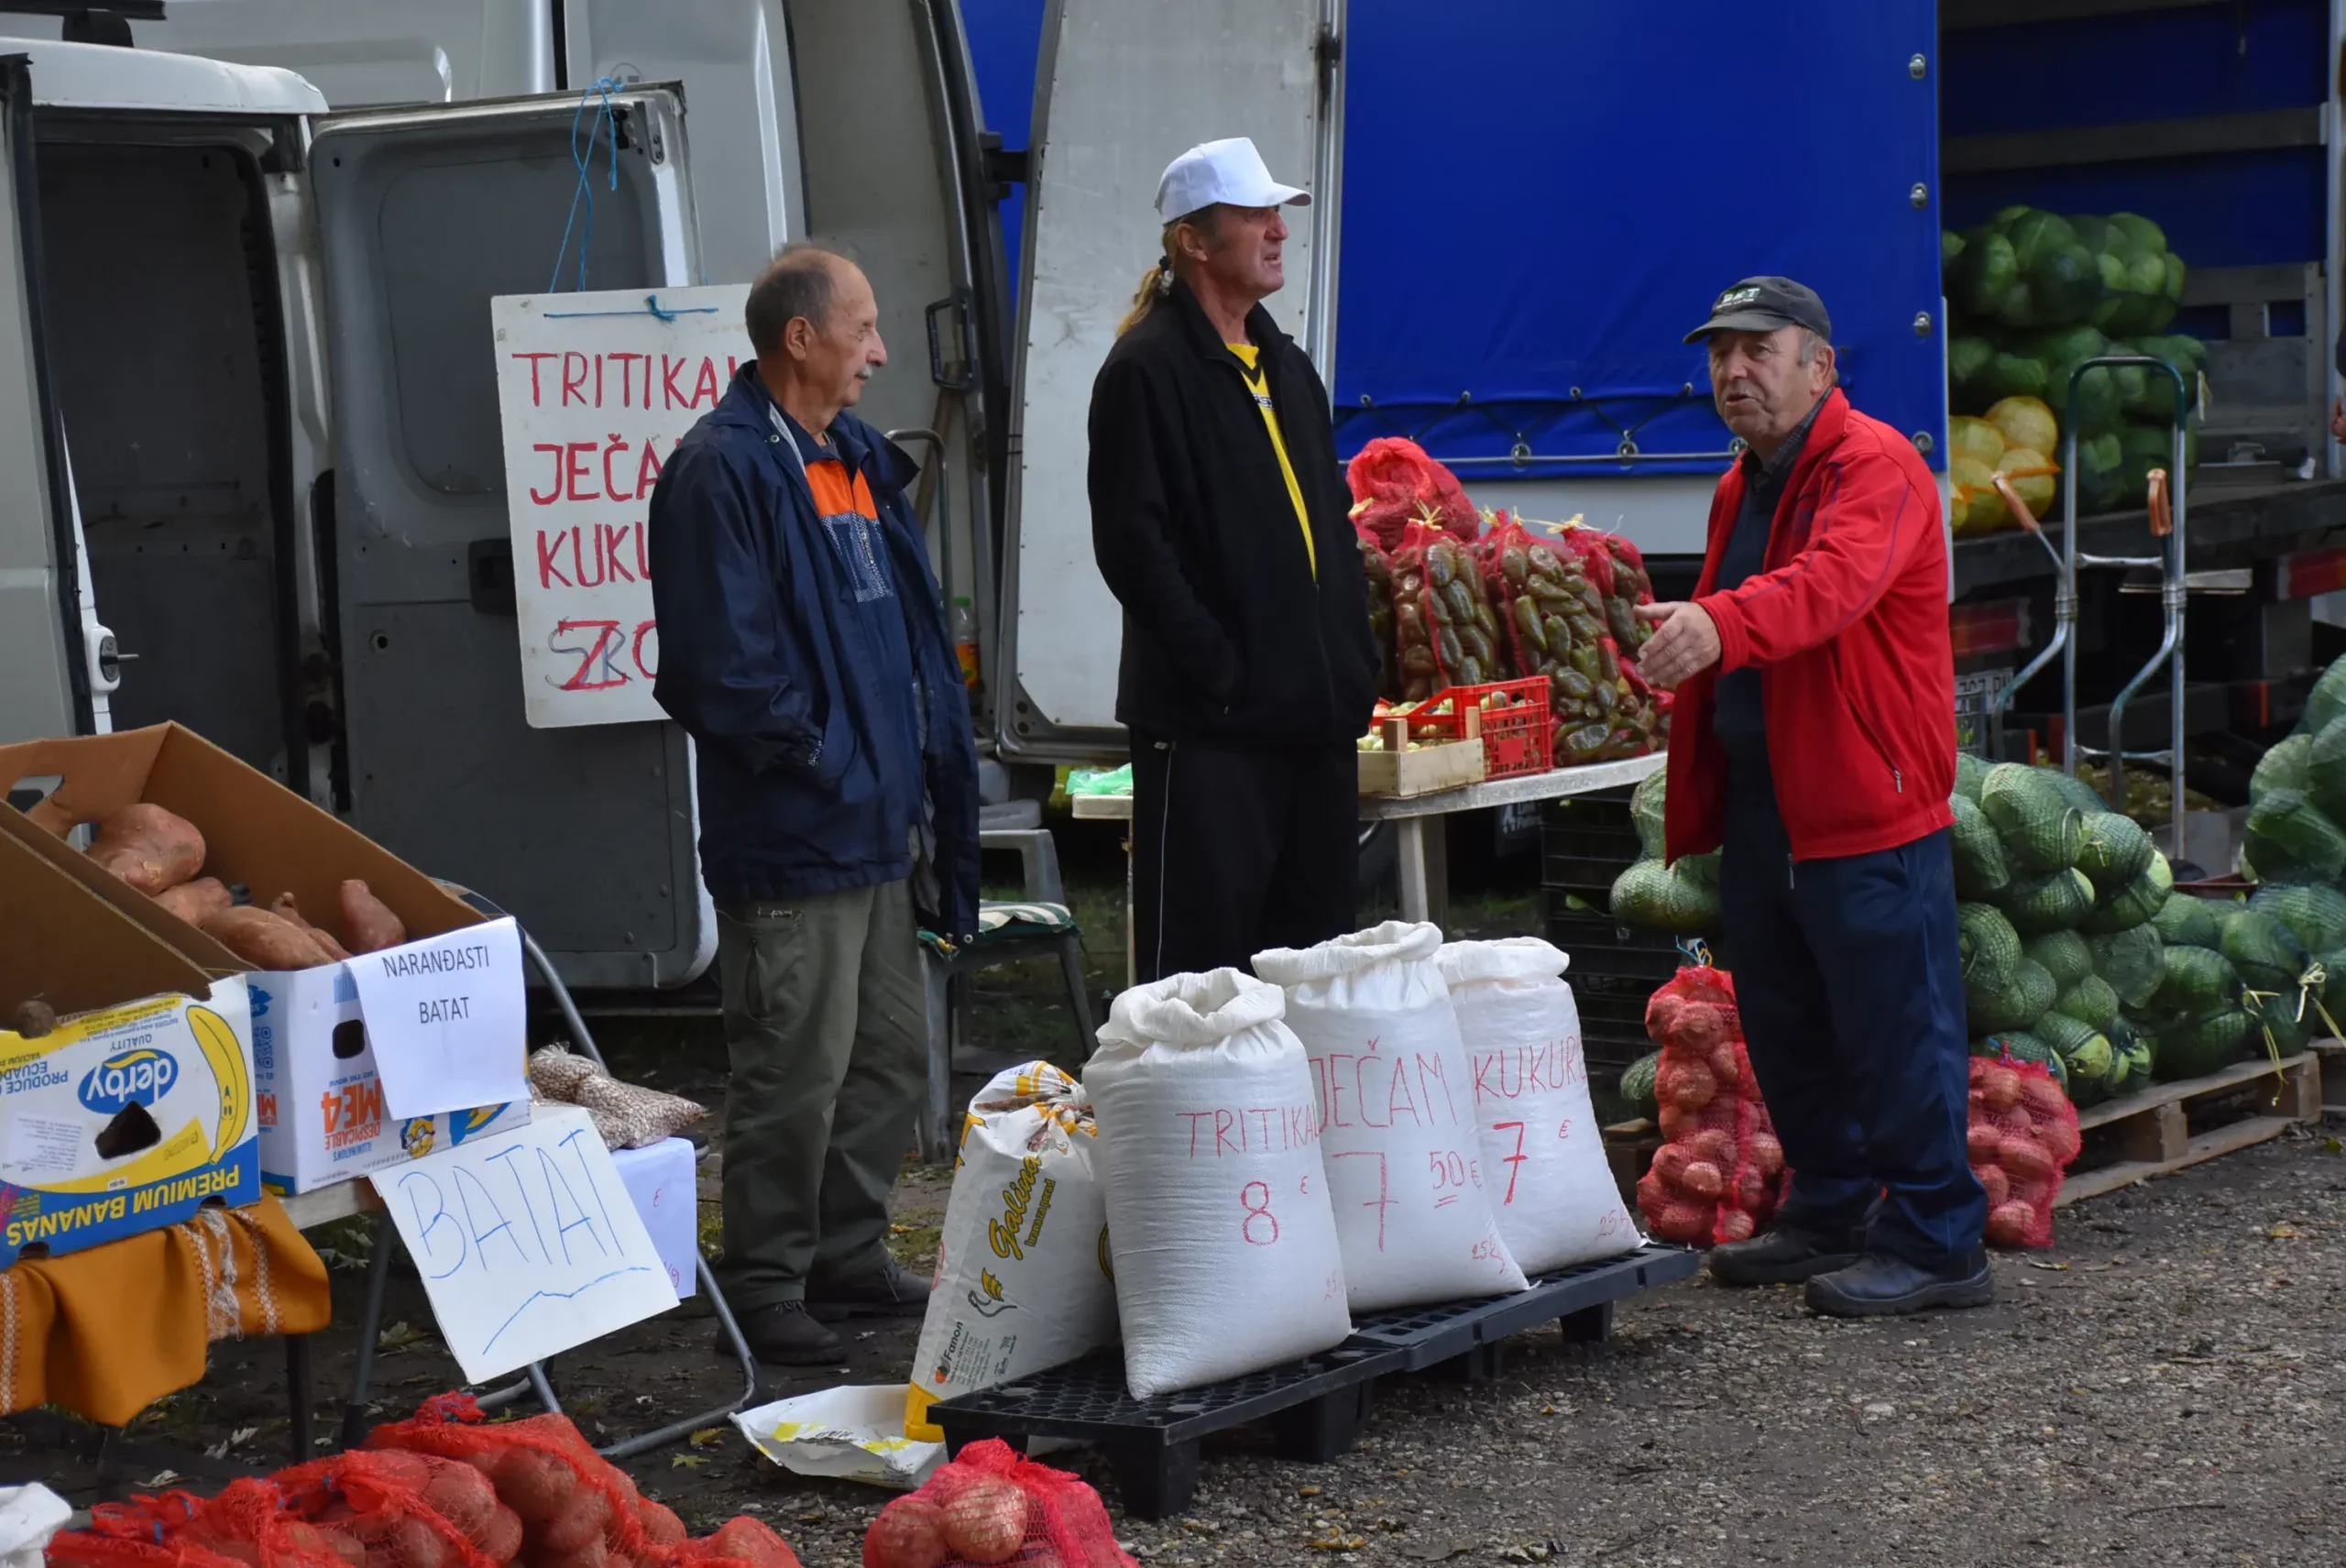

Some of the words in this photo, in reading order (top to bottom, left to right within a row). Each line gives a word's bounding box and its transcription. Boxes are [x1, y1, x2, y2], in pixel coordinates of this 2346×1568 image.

[530, 433, 681, 505] JEČA
[381, 945, 490, 979] NARANĐASTI
[419, 996, 470, 1025] BATAT
[110, 1034, 153, 1053] QUALITY
[5, 1069, 69, 1094] PRODUCE
[86, 1056, 172, 1103] derby
[1307, 1036, 1457, 1134] JEČAM
[324, 1121, 381, 1151] DESPICABLE
[1493, 1121, 1529, 1206] 7
[133, 1164, 240, 1214] PREMIUM
[398, 1128, 625, 1279] BATAT
[988, 1156, 1043, 1262] Galina
[1240, 1180, 1279, 1246] 8
[1332, 1151, 1399, 1253] 7
[6, 1195, 126, 1246] BANANAS
[944, 1321, 965, 1364] Fanon
